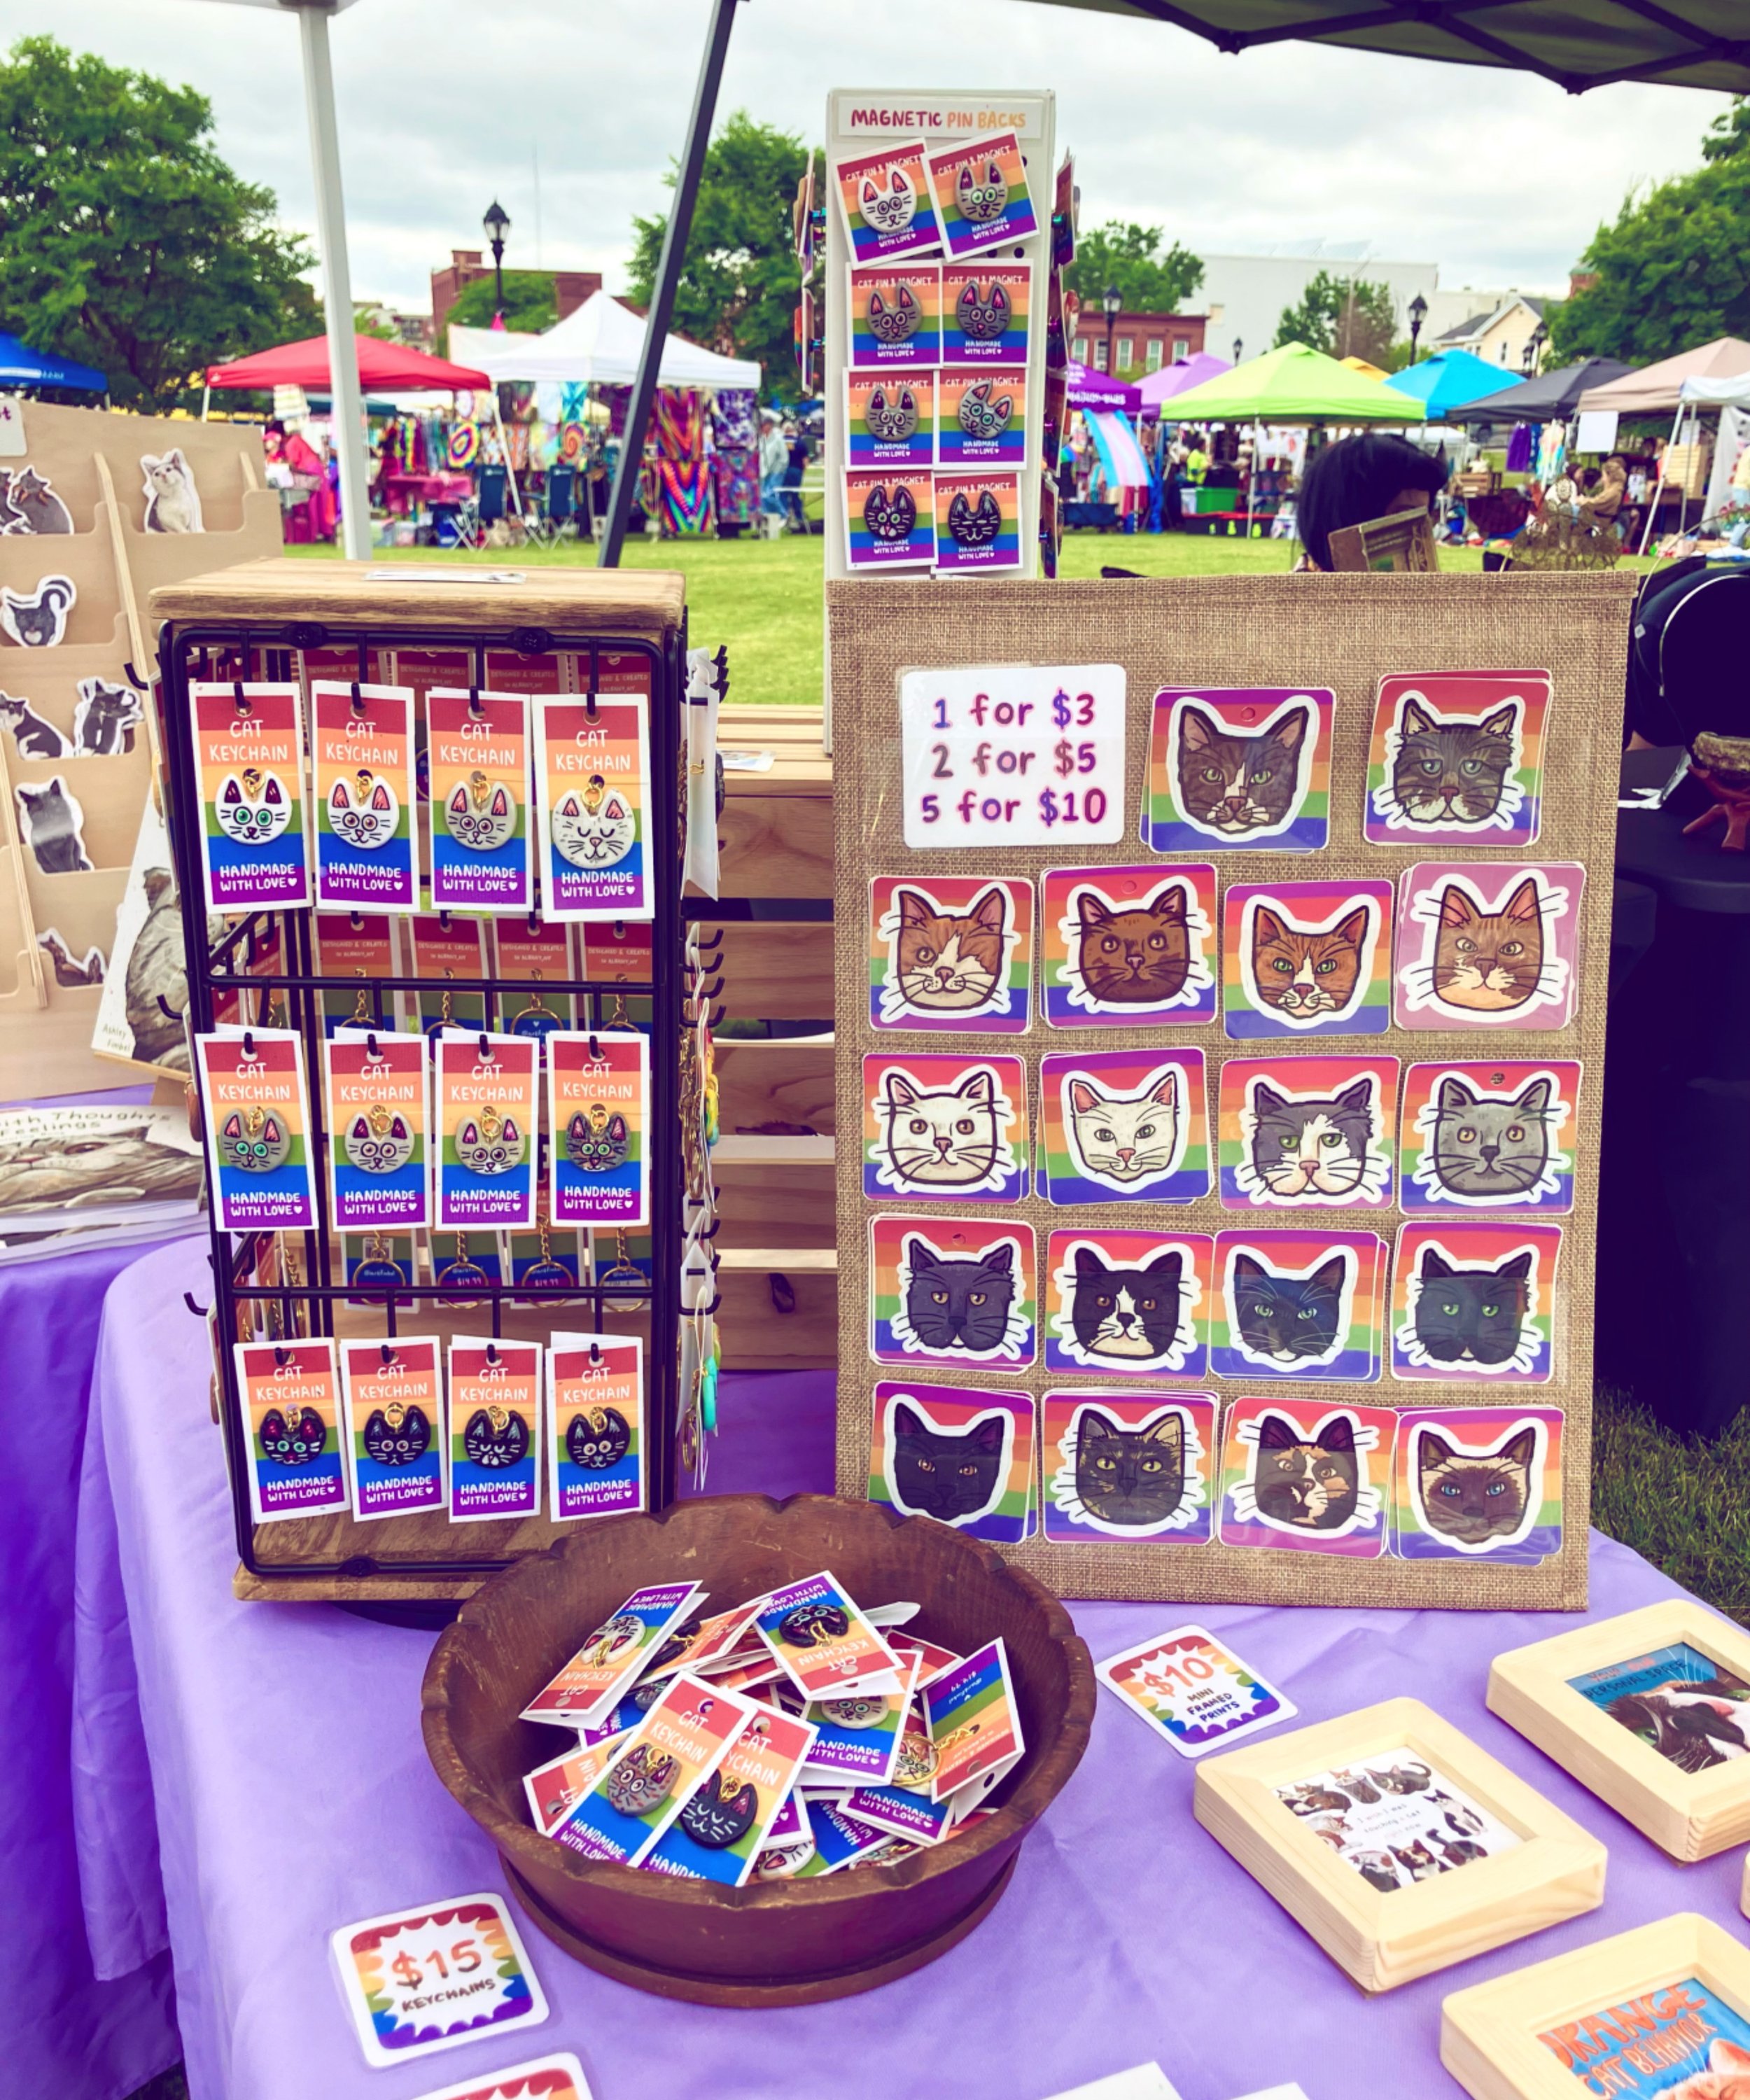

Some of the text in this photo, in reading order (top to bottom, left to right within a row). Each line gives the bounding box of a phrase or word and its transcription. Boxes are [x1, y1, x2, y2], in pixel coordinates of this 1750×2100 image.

[851, 109, 1026, 129] MAGNETIC PIN BACKS
[846, 172, 860, 181] CAT
[938, 164, 953, 176] CAT
[858, 279, 873, 288] CAT
[948, 276, 963, 285] CAT
[855, 382, 870, 391] CAT
[945, 379, 960, 388] CAT
[853, 476, 925, 489] CAT MAGNET
[939, 482, 1010, 496] CAT MAGNET
[933, 687, 1095, 731] 1 for $3
[230, 720, 264, 738] CAT
[346, 722, 376, 740] CAT
[461, 723, 493, 741] CAT
[576, 729, 608, 748] CAT
[210, 744, 288, 762] KEYCHAIN
[326, 743, 398, 764] KEYCHAIN
[440, 745, 515, 765] KEYCHAIN
[931, 738, 1097, 778] 2 for $5
[556, 754, 631, 770] KEYCHAIN
[921, 786, 1107, 827] 5 for $10
[220, 863, 296, 876] HANDMADE
[328, 862, 402, 878] HANDMADE
[443, 864, 516, 878] HANDMADE
[561, 872, 634, 883] HANDMADE
[220, 877, 287, 892] WITH LOVE
[328, 876, 394, 890] WITH LOVE
[443, 879, 508, 892] WITH LOVE
[561, 885, 626, 897] WITH LOVE
[236, 1062, 267, 1079] CAT
[360, 1063, 393, 1080] CAT
[471, 1064, 503, 1081] CAT
[582, 1063, 612, 1079] CAT
[218, 1085, 290, 1100] KEYCHAIN
[341, 1086, 414, 1101] KEYCHAIN
[451, 1086, 523, 1101] KEYCHAIN
[564, 1082, 633, 1098] KEYCHAIN
[52, 1111, 171, 1121] Thoughts
[230, 1192, 300, 1203] HANDMADE
[345, 1190, 416, 1202] HANDMADE
[451, 1190, 520, 1200] HANDMADE
[565, 1186, 632, 1198] HANDMADE
[230, 1205, 294, 1217] WITH LOVE
[345, 1202, 408, 1214] WITH LOVE
[450, 1202, 512, 1213] WITH LOVE
[564, 1199, 624, 1210] WITH LOVE
[274, 1366, 303, 1382] CAT
[377, 1364, 407, 1380] CAT
[479, 1367, 509, 1382] CAT
[582, 1367, 611, 1383] CAT
[256, 1385, 325, 1400] KEYCHAIN
[359, 1383, 428, 1399] KEYCHAIN
[460, 1387, 528, 1401] KEYCHAIN
[564, 1385, 629, 1403] KEYCHAIN
[267, 1476, 334, 1491] HANDMADE
[367, 1476, 432, 1492] HANDMADE
[461, 1481, 526, 1494] HANDMADE
[567, 1479, 631, 1495] HANDMADE
[268, 1488, 327, 1502] WITH LOVE
[367, 1488, 424, 1504] WITH LOVE
[461, 1493, 518, 1506] WITH LOVE
[566, 1491, 624, 1506] WITH LOVE
[794, 1584, 823, 1597] WITH
[764, 1590, 827, 1617] HANDMADE
[797, 1639, 869, 1665] KEYCHAIN
[561, 1670, 617, 1681] KEYCHAIN
[1143, 1657, 1214, 1698] $10
[1583, 1676, 1646, 1699] PERSONAL
[1646, 1658, 1686, 1678] SPACE
[560, 1684, 589, 1695] CAT
[1186, 1687, 1214, 1702] MINI
[1186, 1693, 1233, 1716] FRAMED
[1199, 1701, 1240, 1722] PRINTS
[678, 1711, 709, 1733] CAT
[650, 1721, 706, 1763] KEYCHAIN
[738, 1731, 772, 1756] CAT
[839, 1752, 869, 1764] LOVE
[728, 1751, 781, 1786] YCHAIN
[859, 1798, 922, 1827] WITH LOVE
[863, 1789, 934, 1822] HANDMADE
[561, 1830, 584, 1852] WITH
[570, 1819, 626, 1859] HANDMADE
[391, 1938, 482, 1991] $15
[401, 1977, 496, 2012] KEYCHAINS
[1622, 2012, 1718, 2076] BEHAVIOR
